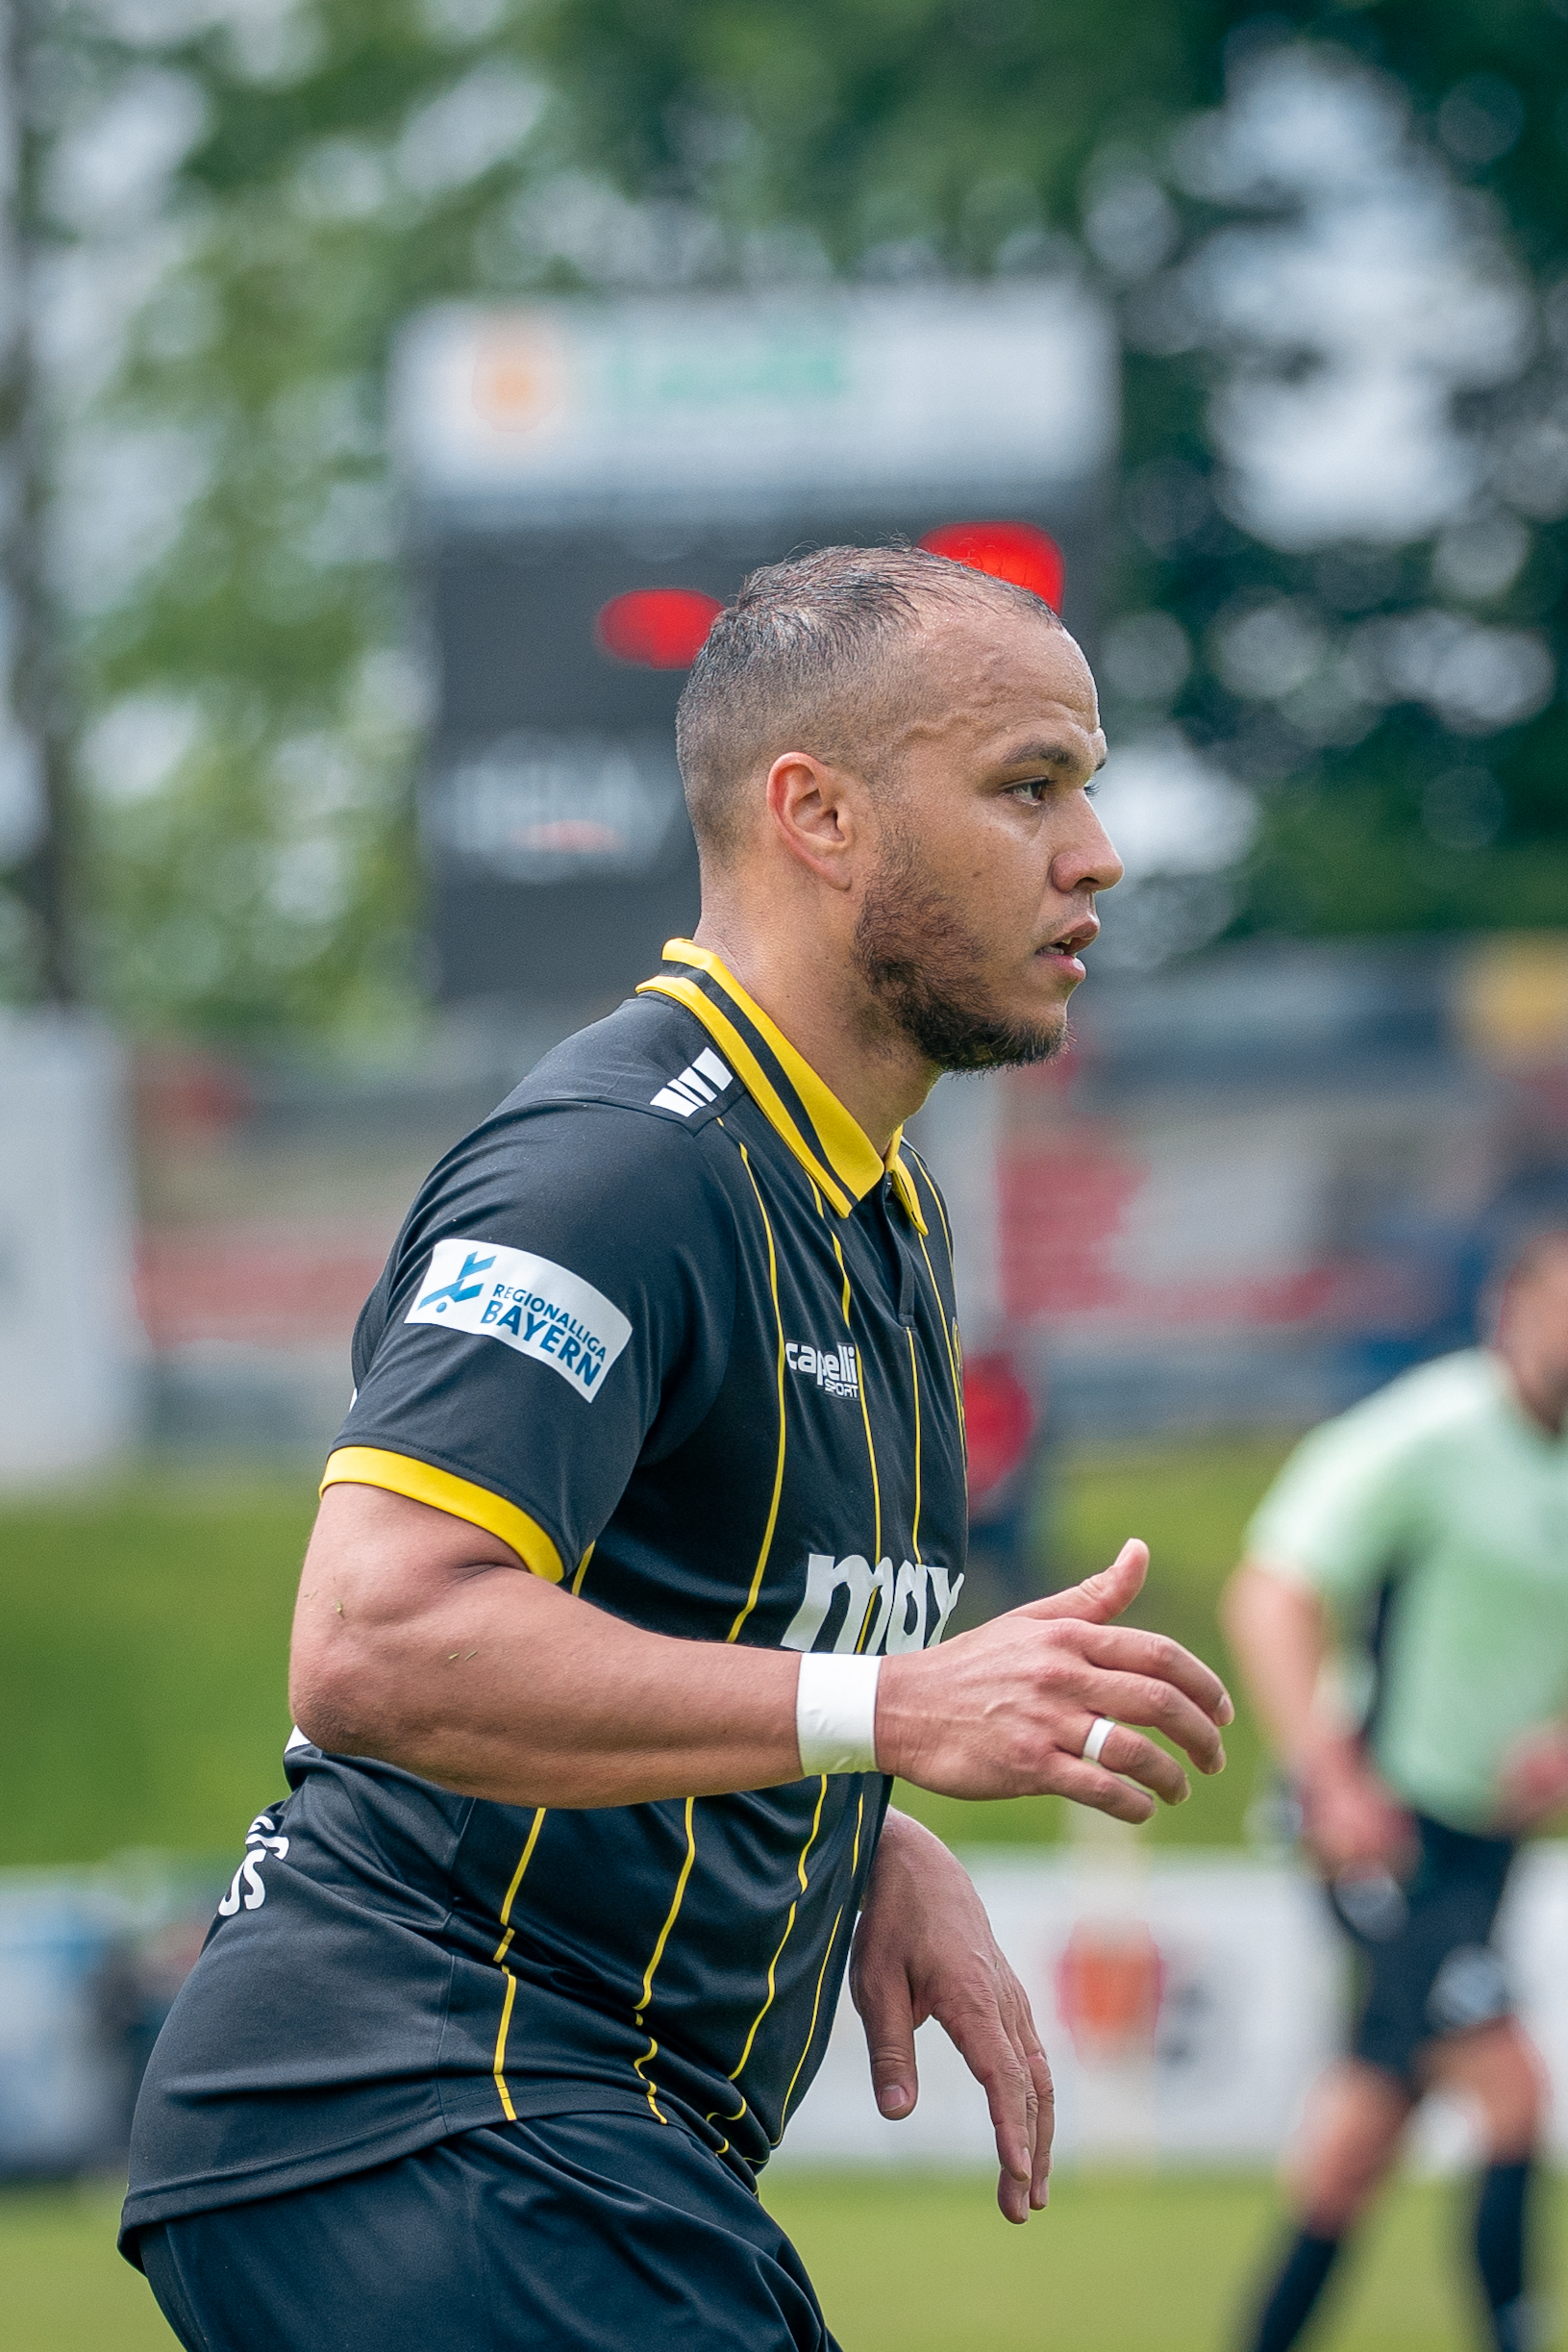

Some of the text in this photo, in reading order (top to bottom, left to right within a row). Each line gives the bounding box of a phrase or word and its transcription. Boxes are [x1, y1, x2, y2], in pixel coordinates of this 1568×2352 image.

[481, 1300, 602, 1387] BAYERN
[492, 1284, 607, 1362] REGIONALLIGA
[785, 1341, 858, 1385] capelli
[825, 1379, 859, 1398] SPORT
